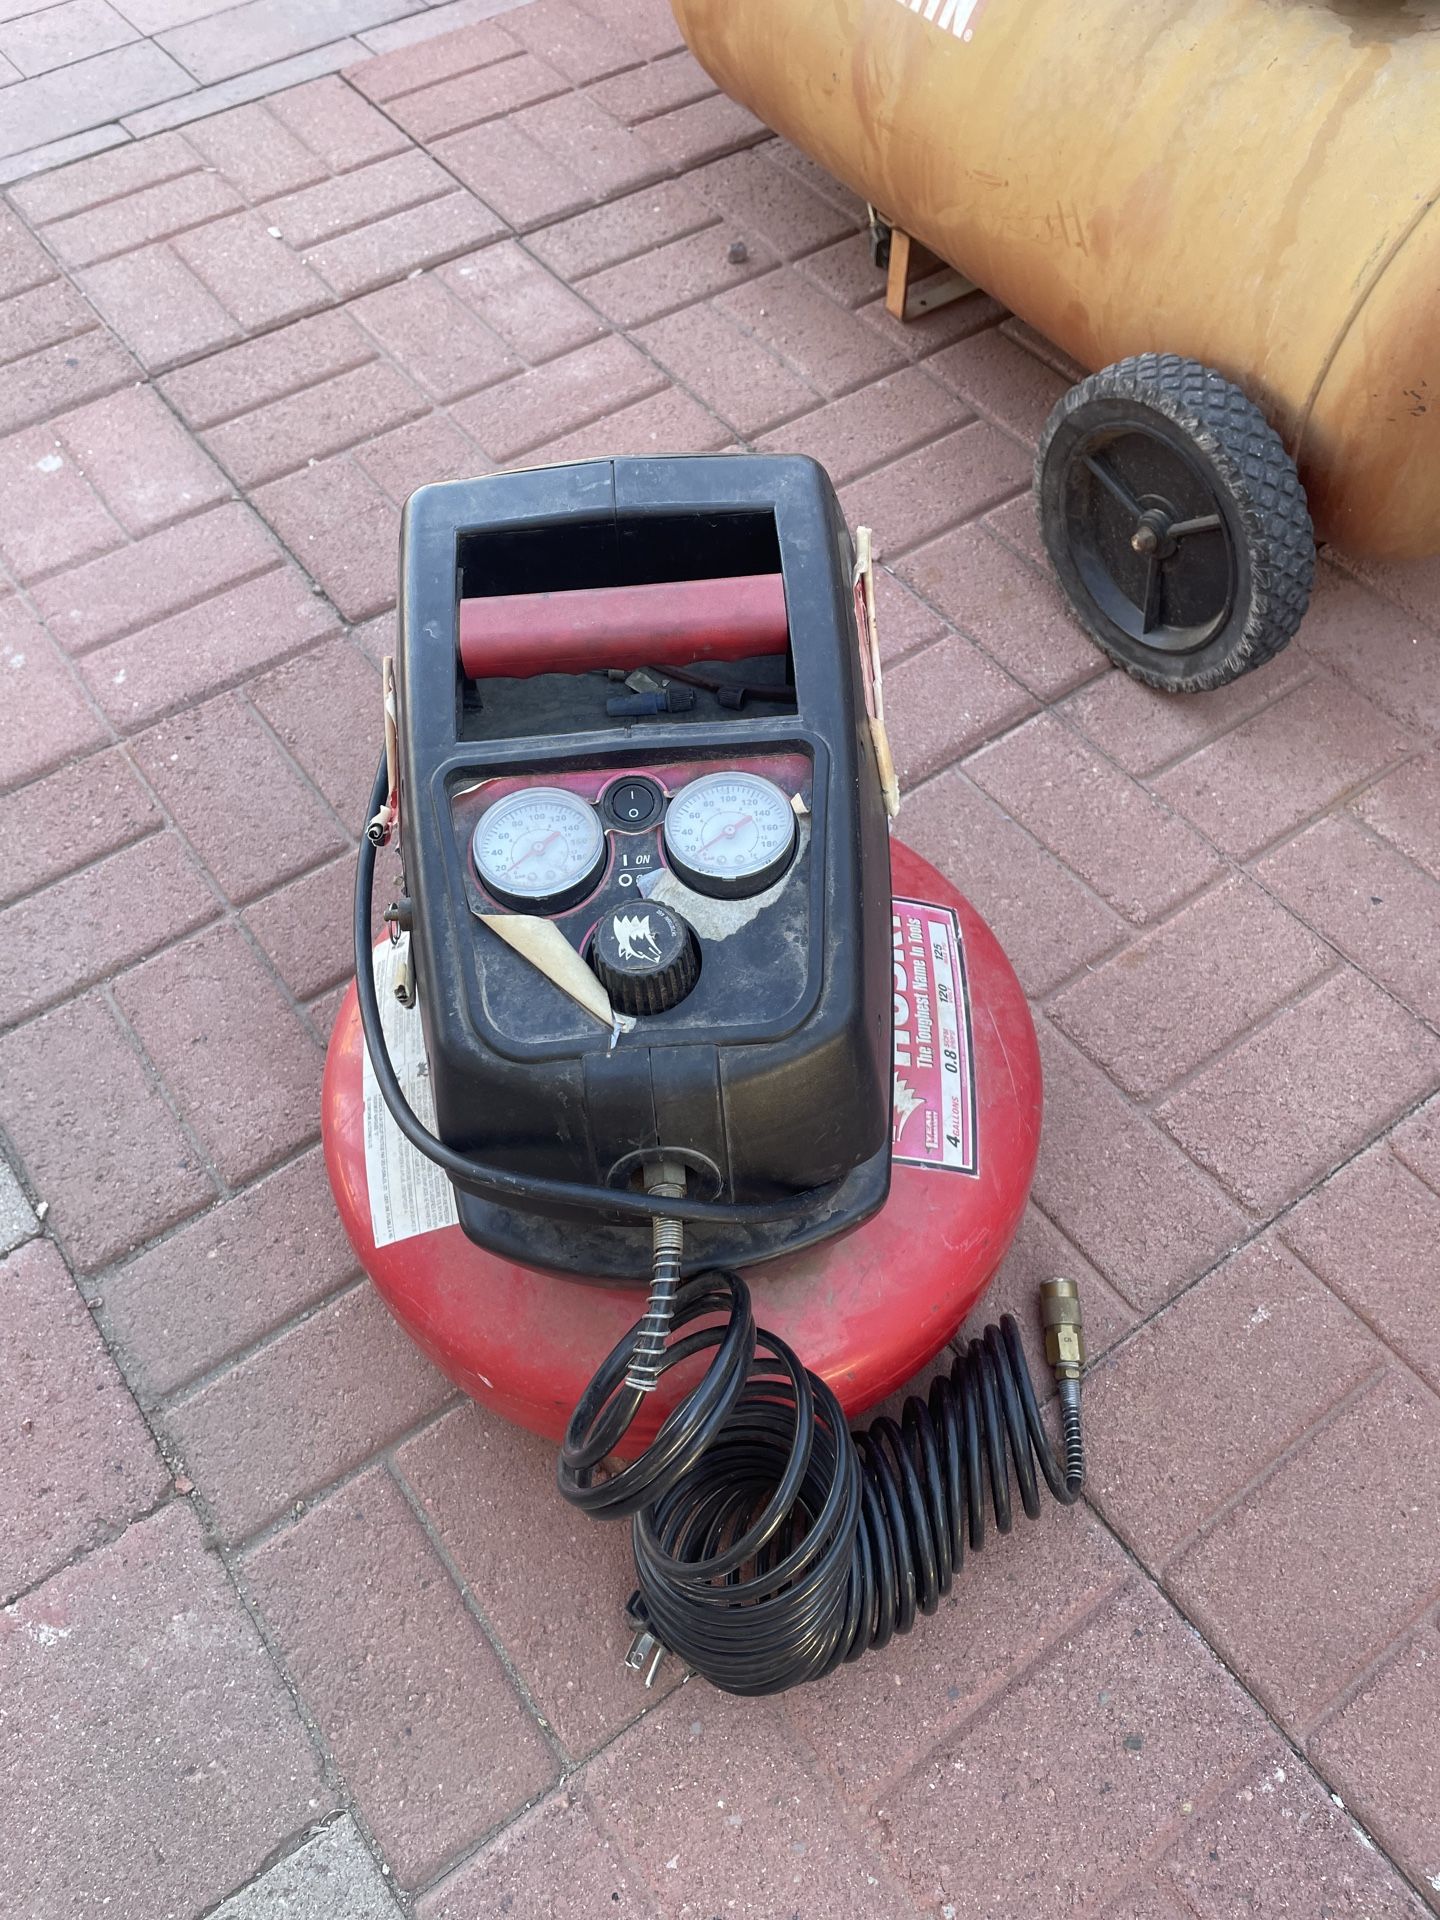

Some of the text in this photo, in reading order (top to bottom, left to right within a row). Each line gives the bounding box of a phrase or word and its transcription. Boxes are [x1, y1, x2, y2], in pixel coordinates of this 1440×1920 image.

[635, 855, 650, 865] ON
[934, 944, 943, 961] 125
[906, 918, 933, 1068] The Toughest Name In Tools
[938, 984, 949, 1003] 120
[944, 1049, 957, 1074] 0.8
[951, 1096, 960, 1137] GALLONS
[946, 1134, 960, 1148] 4
